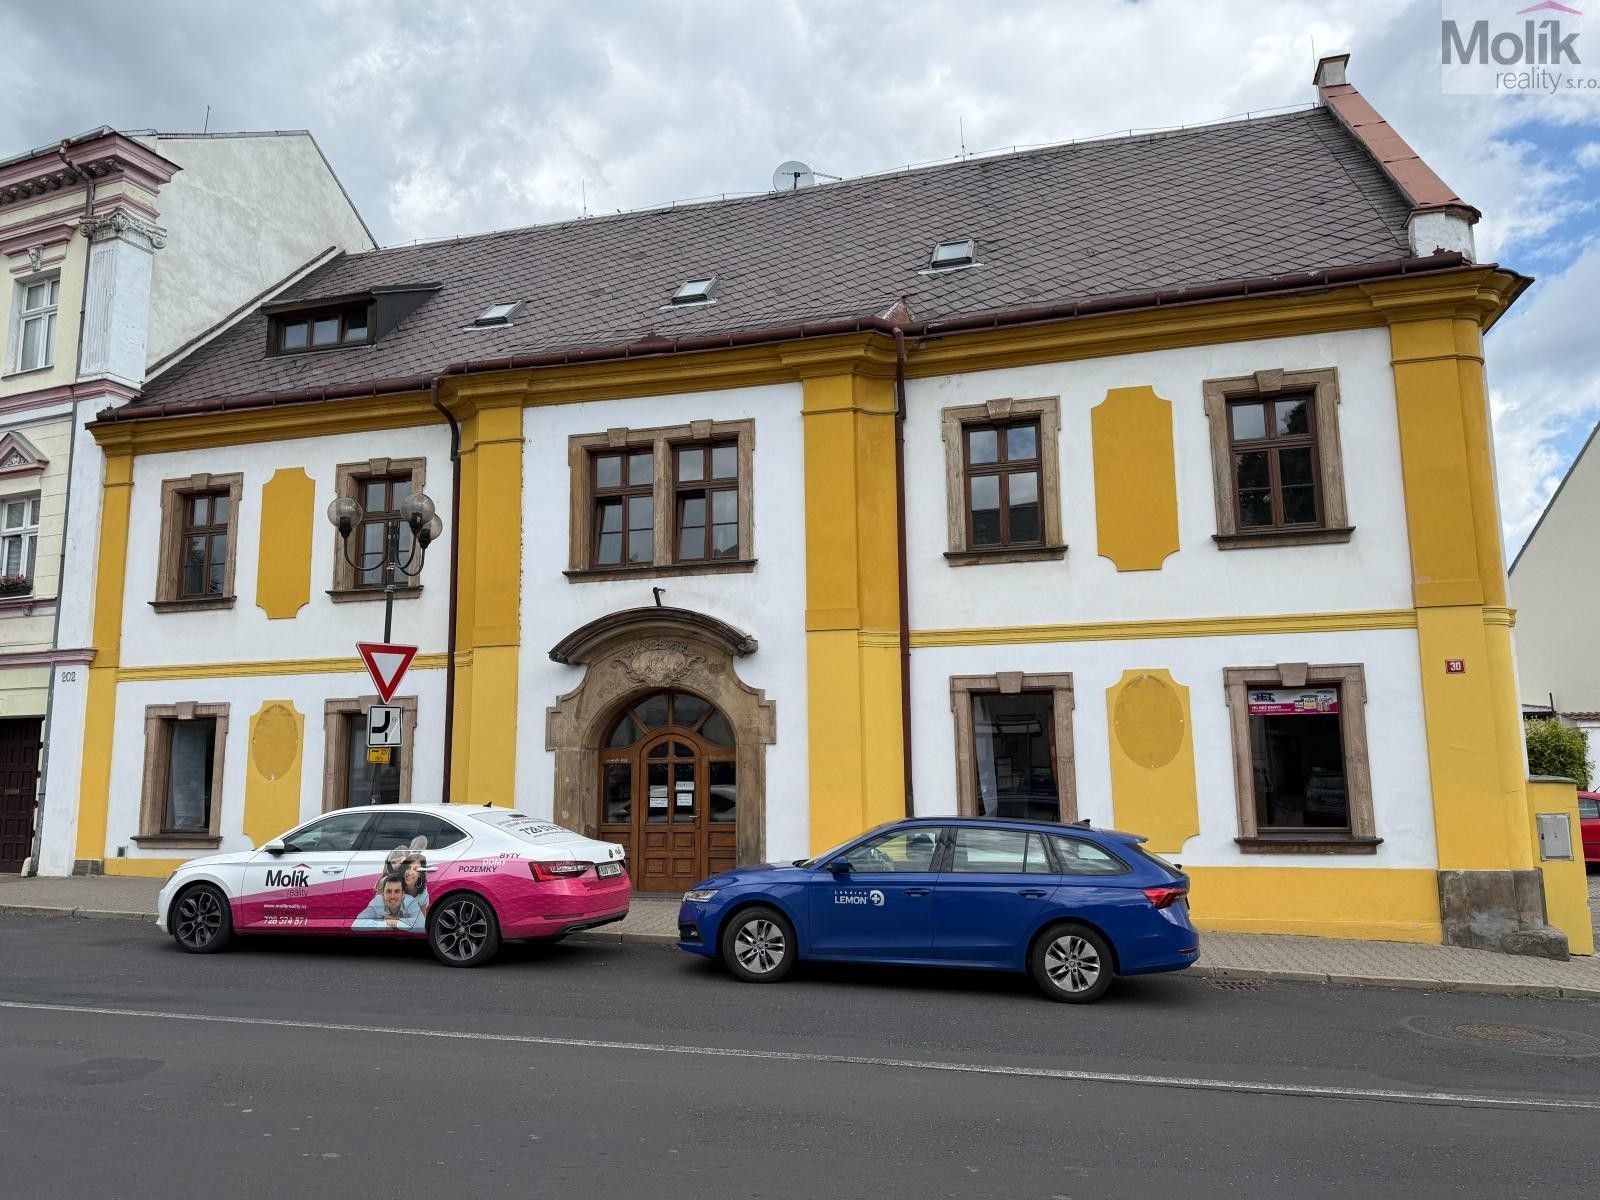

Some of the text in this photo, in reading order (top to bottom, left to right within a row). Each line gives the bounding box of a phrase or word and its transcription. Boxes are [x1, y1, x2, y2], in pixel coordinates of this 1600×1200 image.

[1450, 661, 1462, 671] 30
[61, 671, 76, 683] 202
[482, 858, 506, 866] DOMY
[458, 865, 498, 873] POZEMKY
[265, 870, 309, 887] Molík
[287, 888, 308, 896] reality
[834, 896, 867, 904] LEMON
